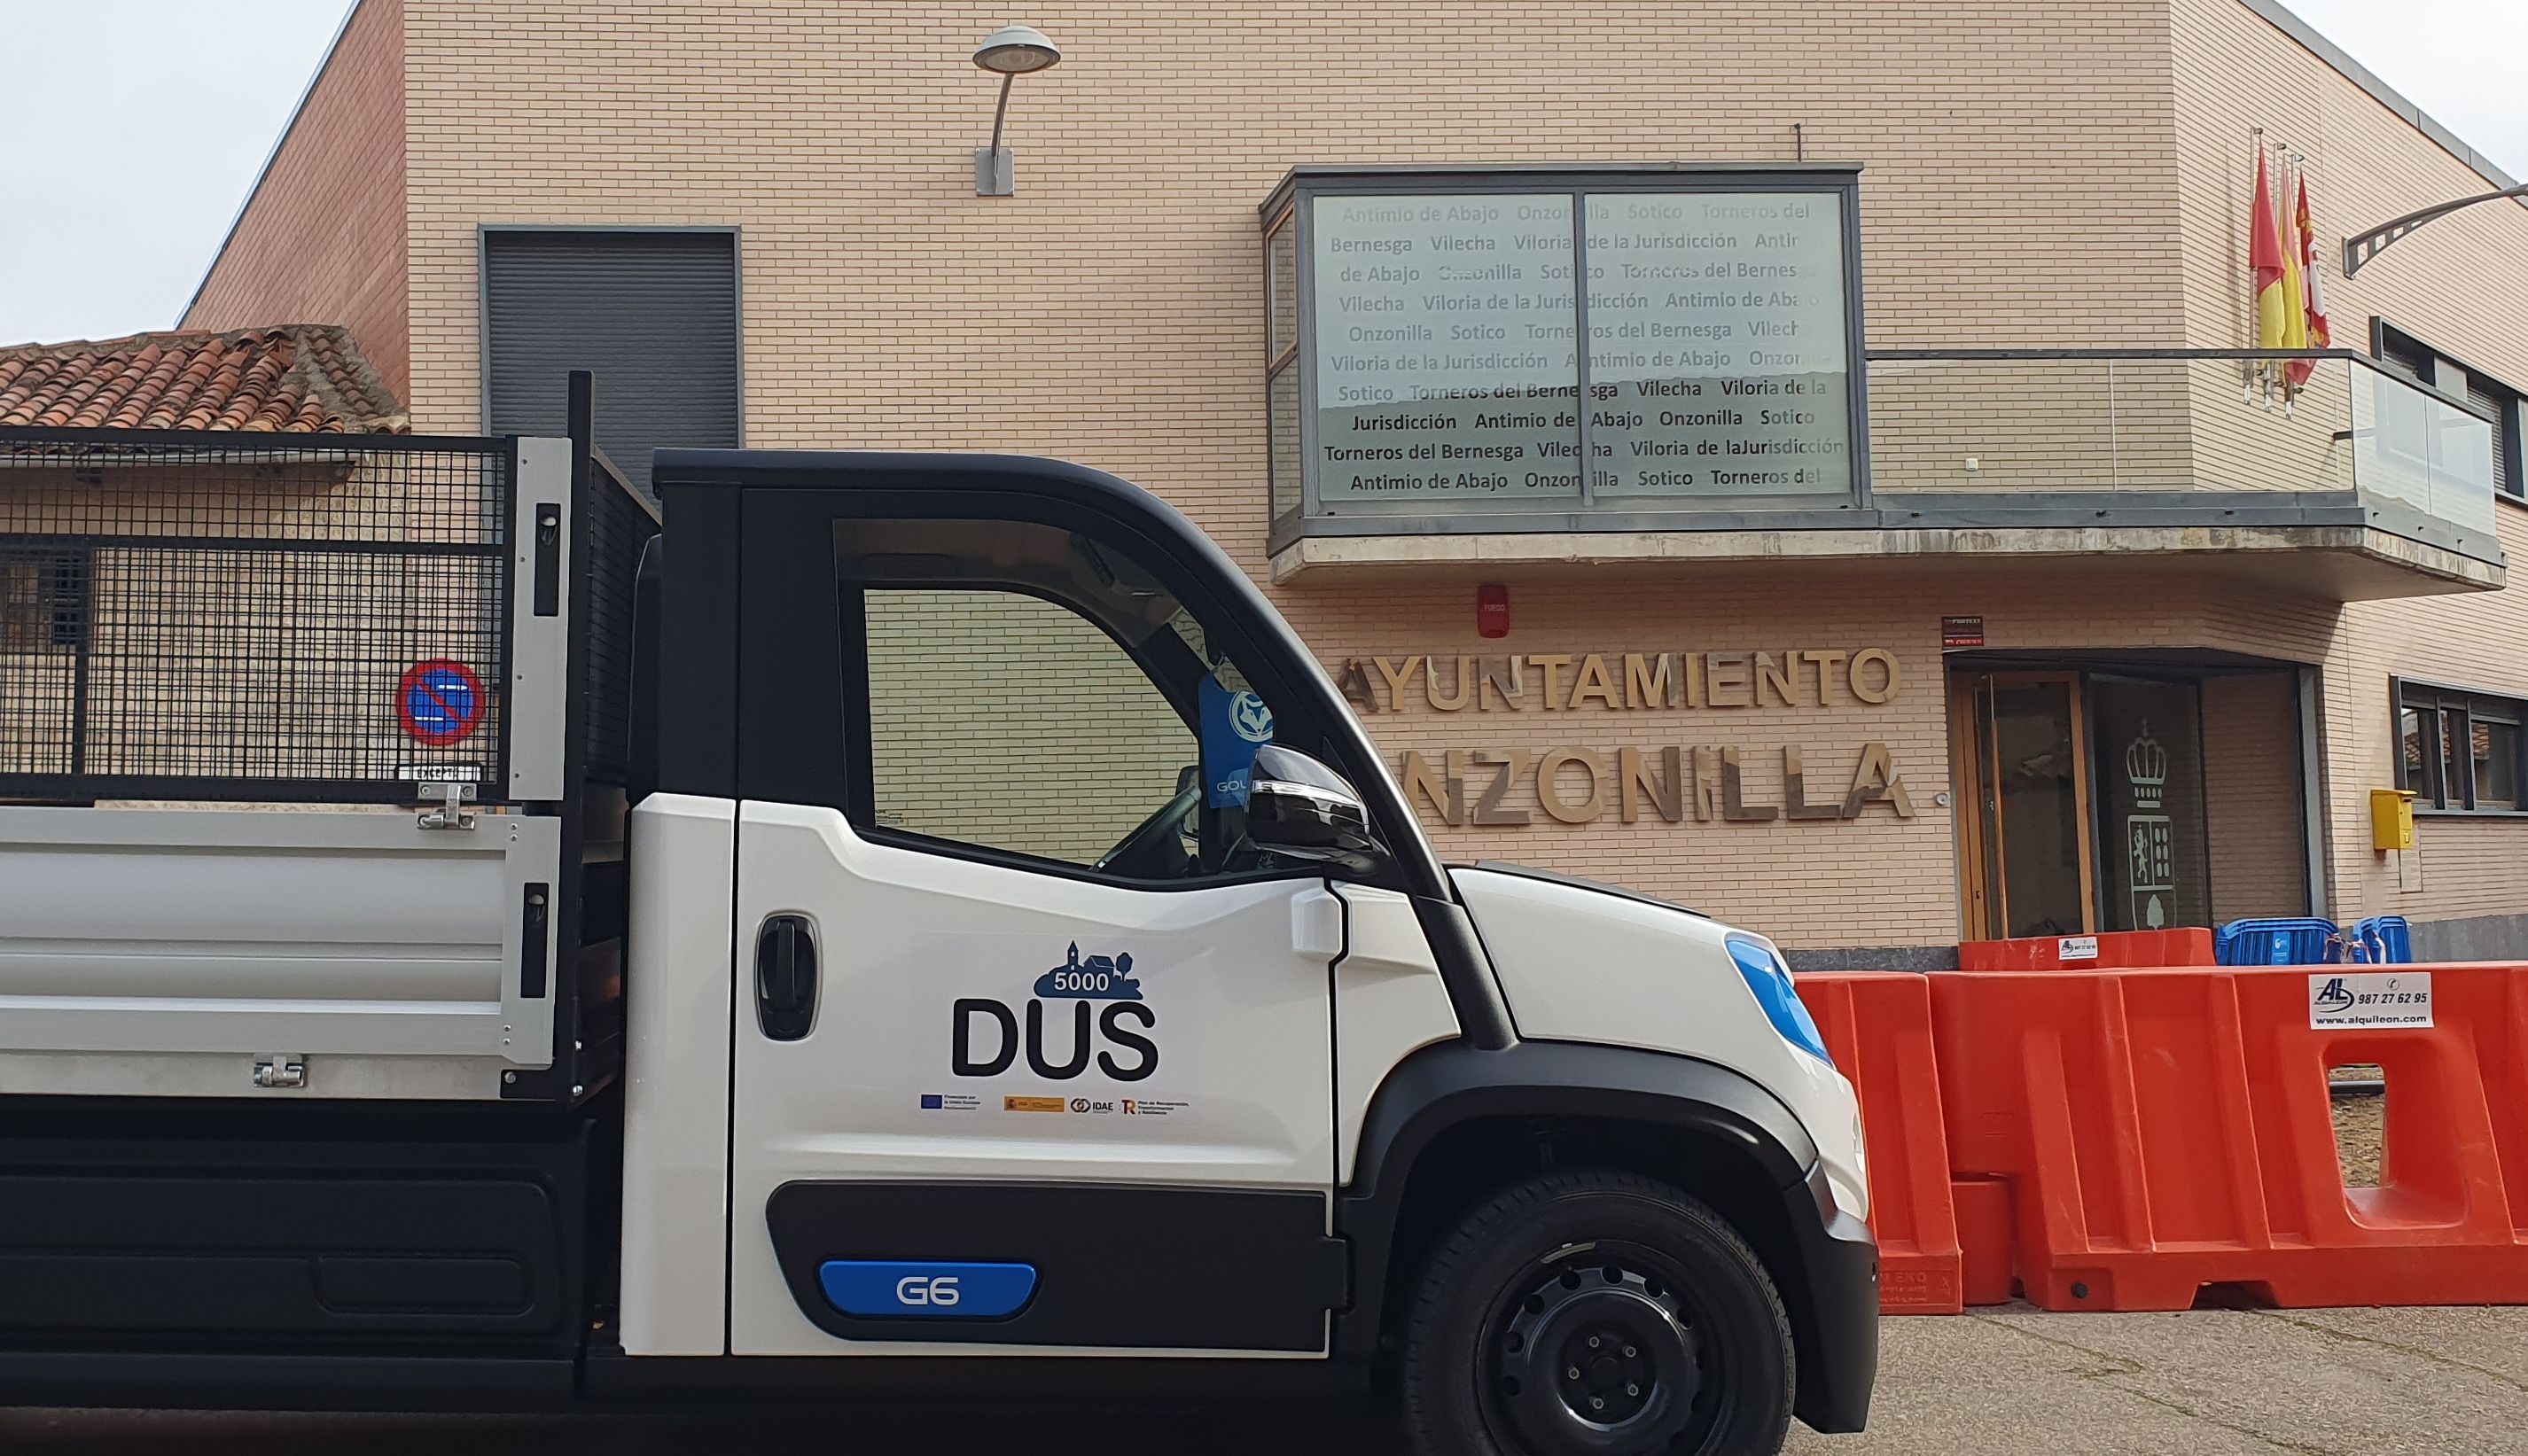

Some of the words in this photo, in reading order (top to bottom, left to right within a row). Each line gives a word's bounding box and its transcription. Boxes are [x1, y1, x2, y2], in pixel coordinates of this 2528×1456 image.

[1343, 206, 1413, 222] Antimio
[1420, 206, 1440, 221] de
[1447, 206, 1498, 223] Abajo
[1628, 204, 1682, 220] Sotico
[1702, 204, 1777, 219] Torneros
[1783, 202, 1809, 218] del
[1330, 237, 1412, 254] Bernesga
[1431, 235, 1496, 250] Vilecha
[1513, 235, 1572, 250] Viloria
[1588, 234, 1609, 249] de
[1614, 233, 1629, 248] la
[1634, 232, 1737, 248] Jurisdicción
[1340, 267, 1362, 282] de
[1368, 266, 1420, 285] Abajo
[1705, 262, 1730, 277] del
[1339, 296, 1405, 312] Vilecha
[1423, 295, 1481, 311] Viloria
[1486, 294, 1508, 310] de
[1515, 294, 1530, 309] la
[1535, 292, 1648, 309] Jurisdicción
[1665, 292, 1736, 308] Antimio
[1741, 292, 1763, 308] de
[1348, 324, 1432, 342] Onzonilla
[1450, 324, 1505, 340] Sotico
[1619, 322, 1645, 338] del
[1650, 323, 1731, 340] Bernesga
[1331, 355, 1389, 371] Viloria
[1395, 354, 1417, 370] de
[1424, 354, 1438, 370] la
[1443, 352, 1548, 370] Jurisdicción
[1651, 352, 1674, 367] de
[1679, 351, 1730, 370] Abajo
[1338, 385, 1393, 401] Sotico
[1409, 385, 1487, 400] Torneros
[1494, 384, 1520, 398] del
[1526, 383, 1618, 401] Bernesga
[1637, 381, 1701, 396] Vilecha
[1721, 380, 1778, 395] Viloria
[1784, 379, 1805, 394] de
[1812, 379, 1826, 394] la
[1352, 413, 1456, 431] Jurisdicción
[1475, 413, 1546, 429] Antimio
[1553, 412, 1575, 427] de
[1591, 411, 1642, 430] Abajo
[1659, 409, 1743, 426] Onzonilla
[1760, 409, 1814, 424] Sotico
[1324, 446, 1402, 461] Torneros
[1408, 444, 1435, 459] del
[1442, 444, 1524, 461] Bernesga
[1631, 440, 1689, 455] Viloria
[1697, 440, 1718, 455] de
[1350, 475, 1422, 491] Antimio
[1428, 473, 1450, 489] de
[1455, 473, 1508, 491] Abajo
[1638, 470, 1693, 486] Sotico
[1711, 470, 1788, 485] Torneros
[1794, 468, 1820, 484] del
[1337, 648, 1901, 712] AYUNTAMIENTO
[1401, 743, 1916, 825] NZONILLA
[1055, 973, 1109, 992] 5000
[2317, 978, 2348, 1001] AL
[2358, 994, 2378, 1004] 987
[2381, 993, 2395, 1004] 27
[2397, 993, 2411, 1003] 62
[2414, 993, 2427, 1003] 95
[2316, 1016, 2427, 1025] www.alquileon.com
[952, 998, 1159, 1081] DUS
[1092, 1102, 1113, 1110] IDAE
[896, 1276, 959, 1305] G6
